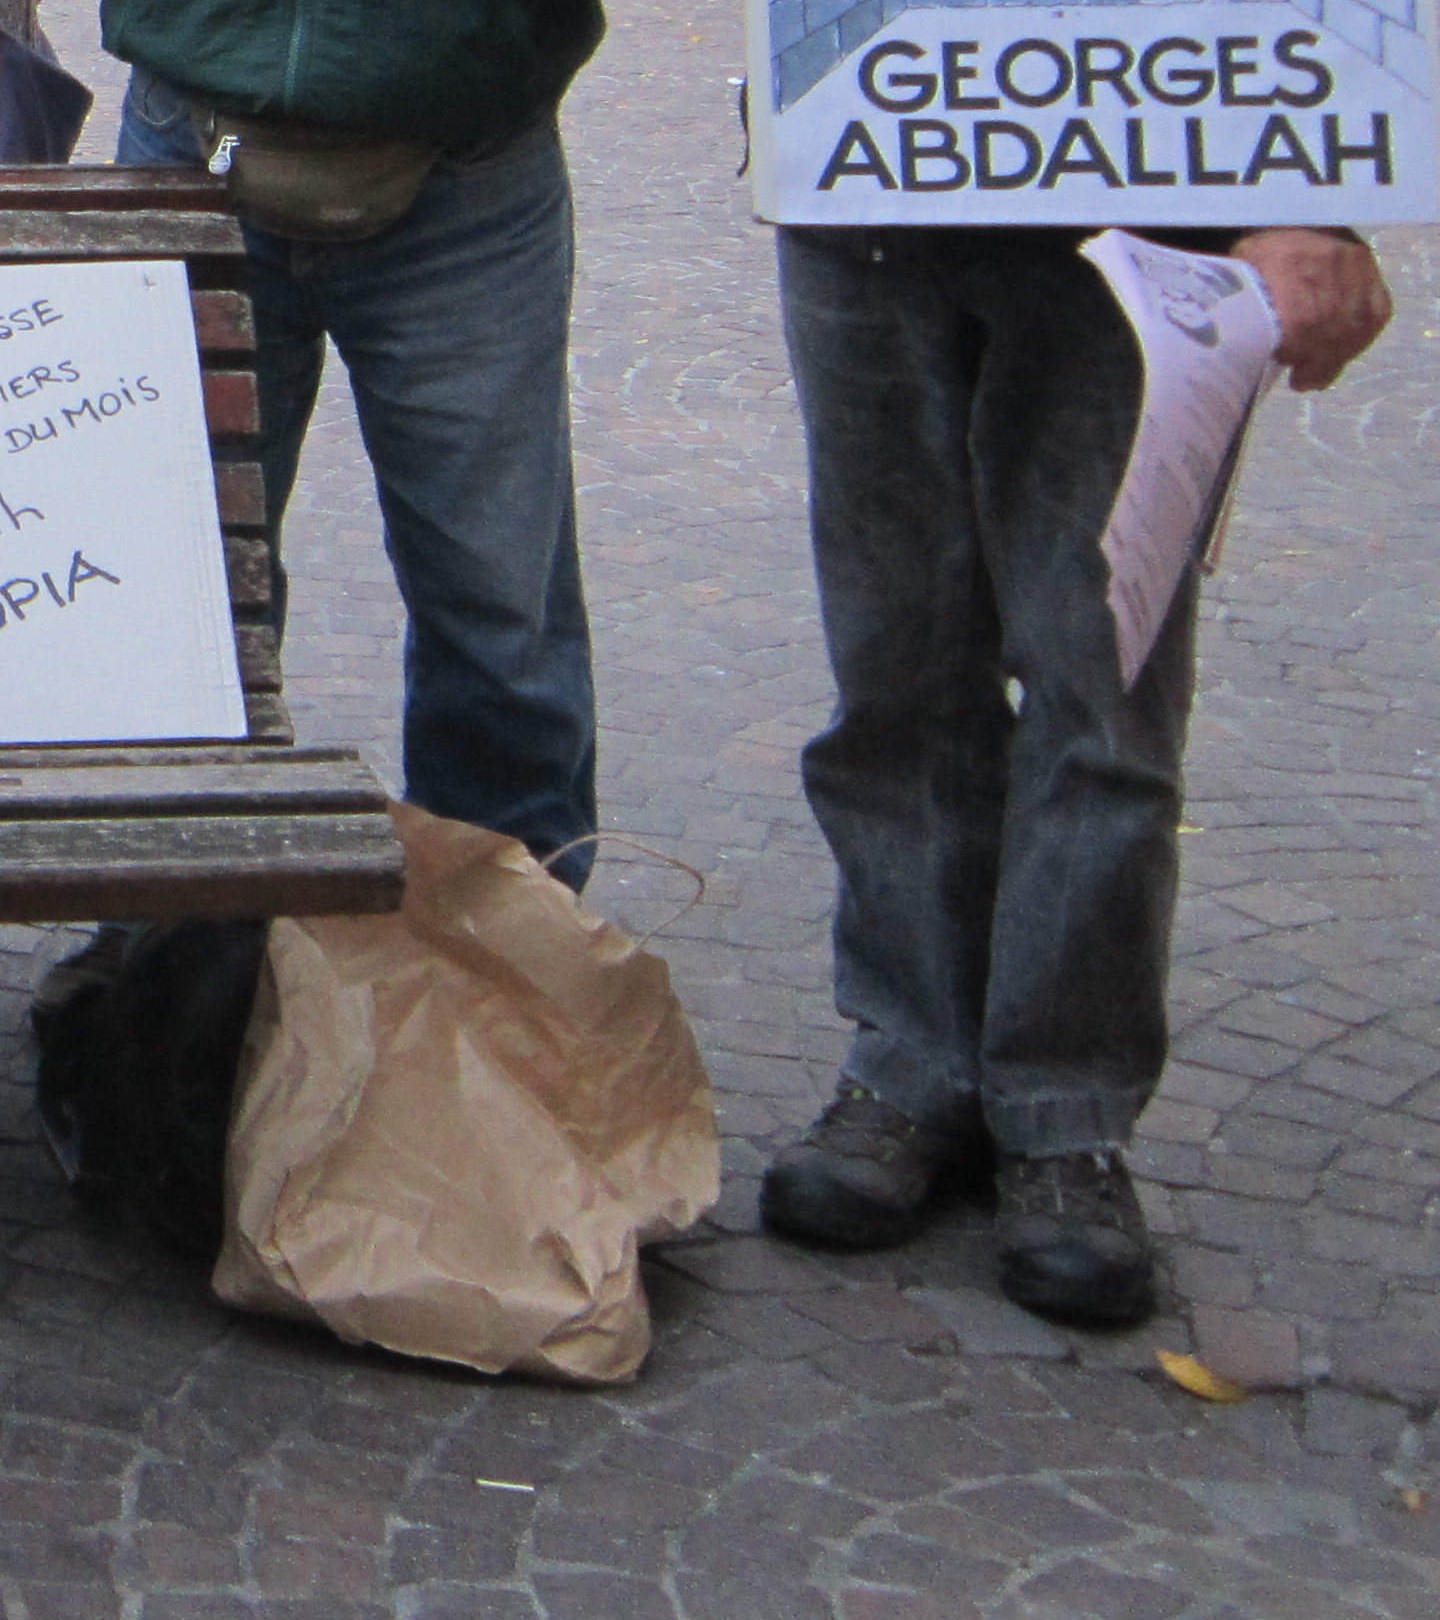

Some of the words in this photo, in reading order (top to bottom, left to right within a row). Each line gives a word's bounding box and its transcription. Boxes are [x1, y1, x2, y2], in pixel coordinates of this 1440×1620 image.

[857, 29, 1333, 114] GEORGES
[816, 112, 1395, 193] ABDALLAH
[4, 415, 60, 455] DU
